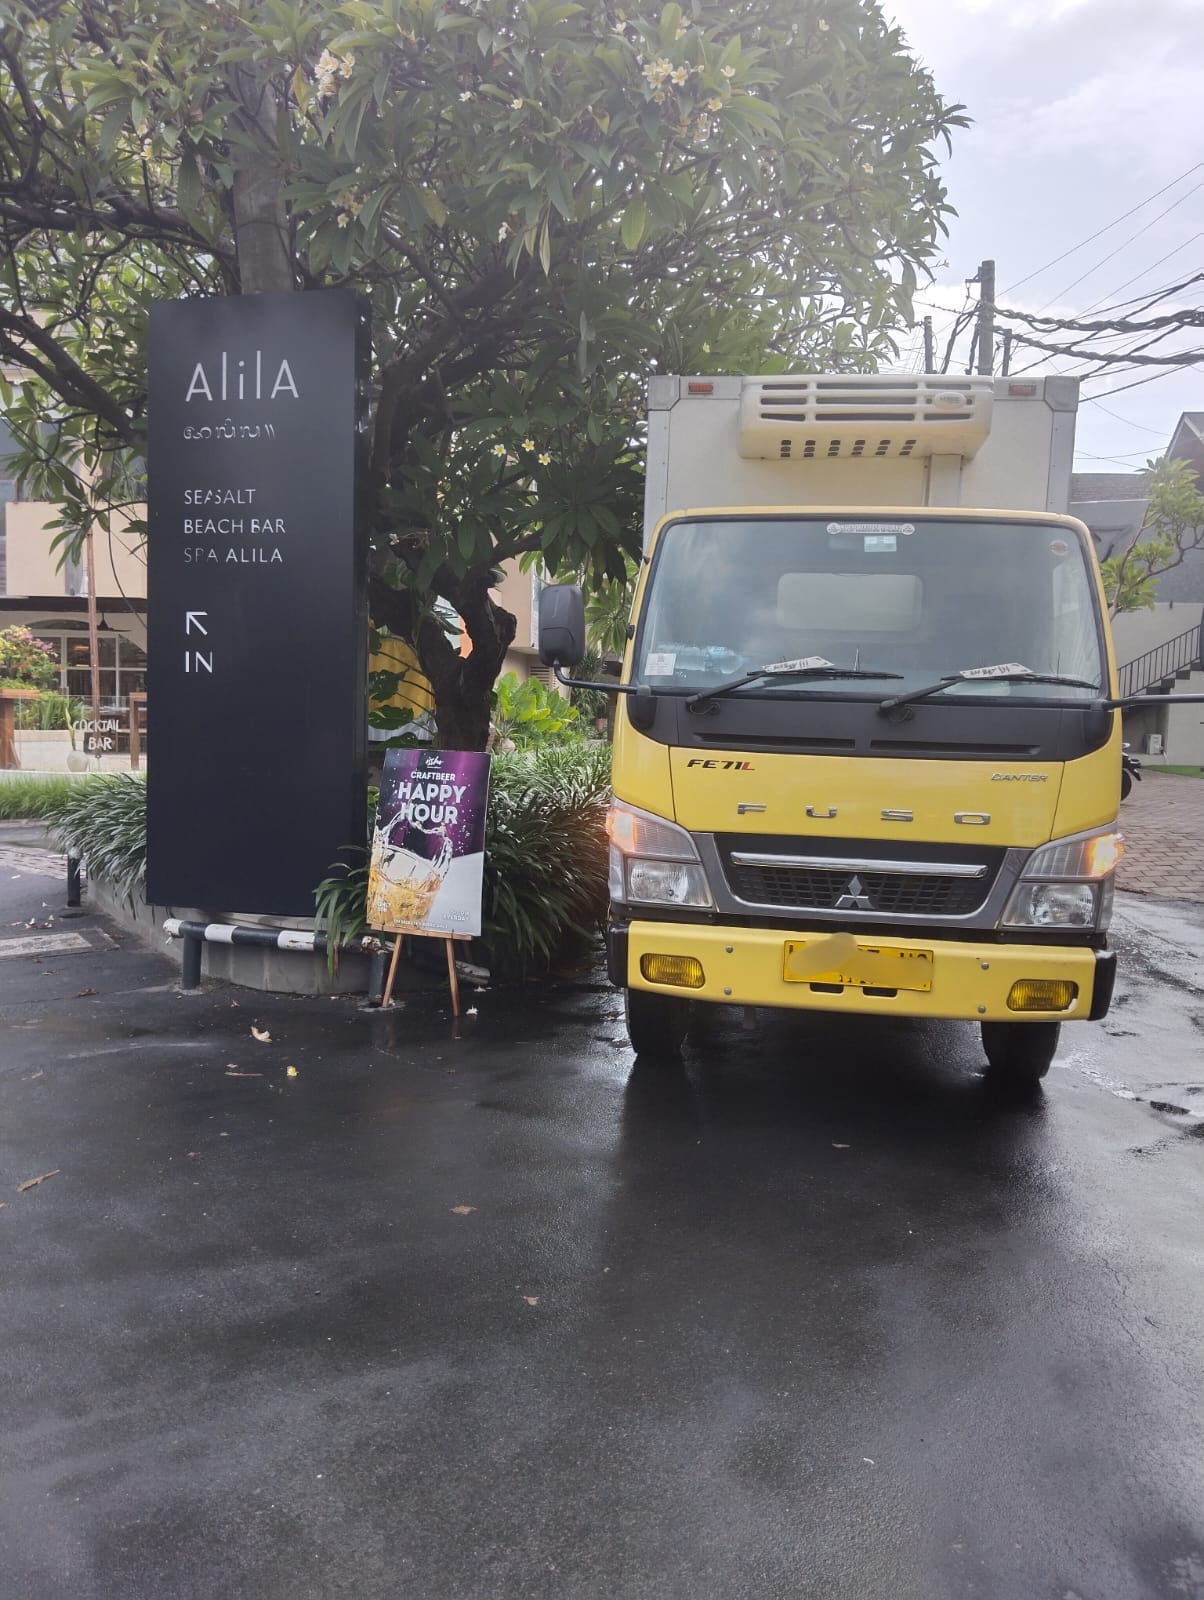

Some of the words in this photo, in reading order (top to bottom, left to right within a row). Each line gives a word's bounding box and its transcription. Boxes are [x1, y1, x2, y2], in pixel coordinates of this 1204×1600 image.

[184, 488, 256, 504] SEASALT
[184, 518, 244, 534] BEACH
[251, 518, 286, 534] BAR
[184, 547, 219, 563] SPA
[225, 547, 283, 563] ALILA
[185, 650, 213, 673] IN
[72, 719, 122, 732] COCKTAIL
[88, 737, 112, 751] BAR
[687, 759, 755, 771] FE71L
[410, 771, 456, 782] CRAFTBEER
[991, 772, 1048, 783] CANTER
[398, 781, 467, 805] HAPPY
[399, 802, 459, 825] HOUR
[737, 802, 991, 826] FUSO
